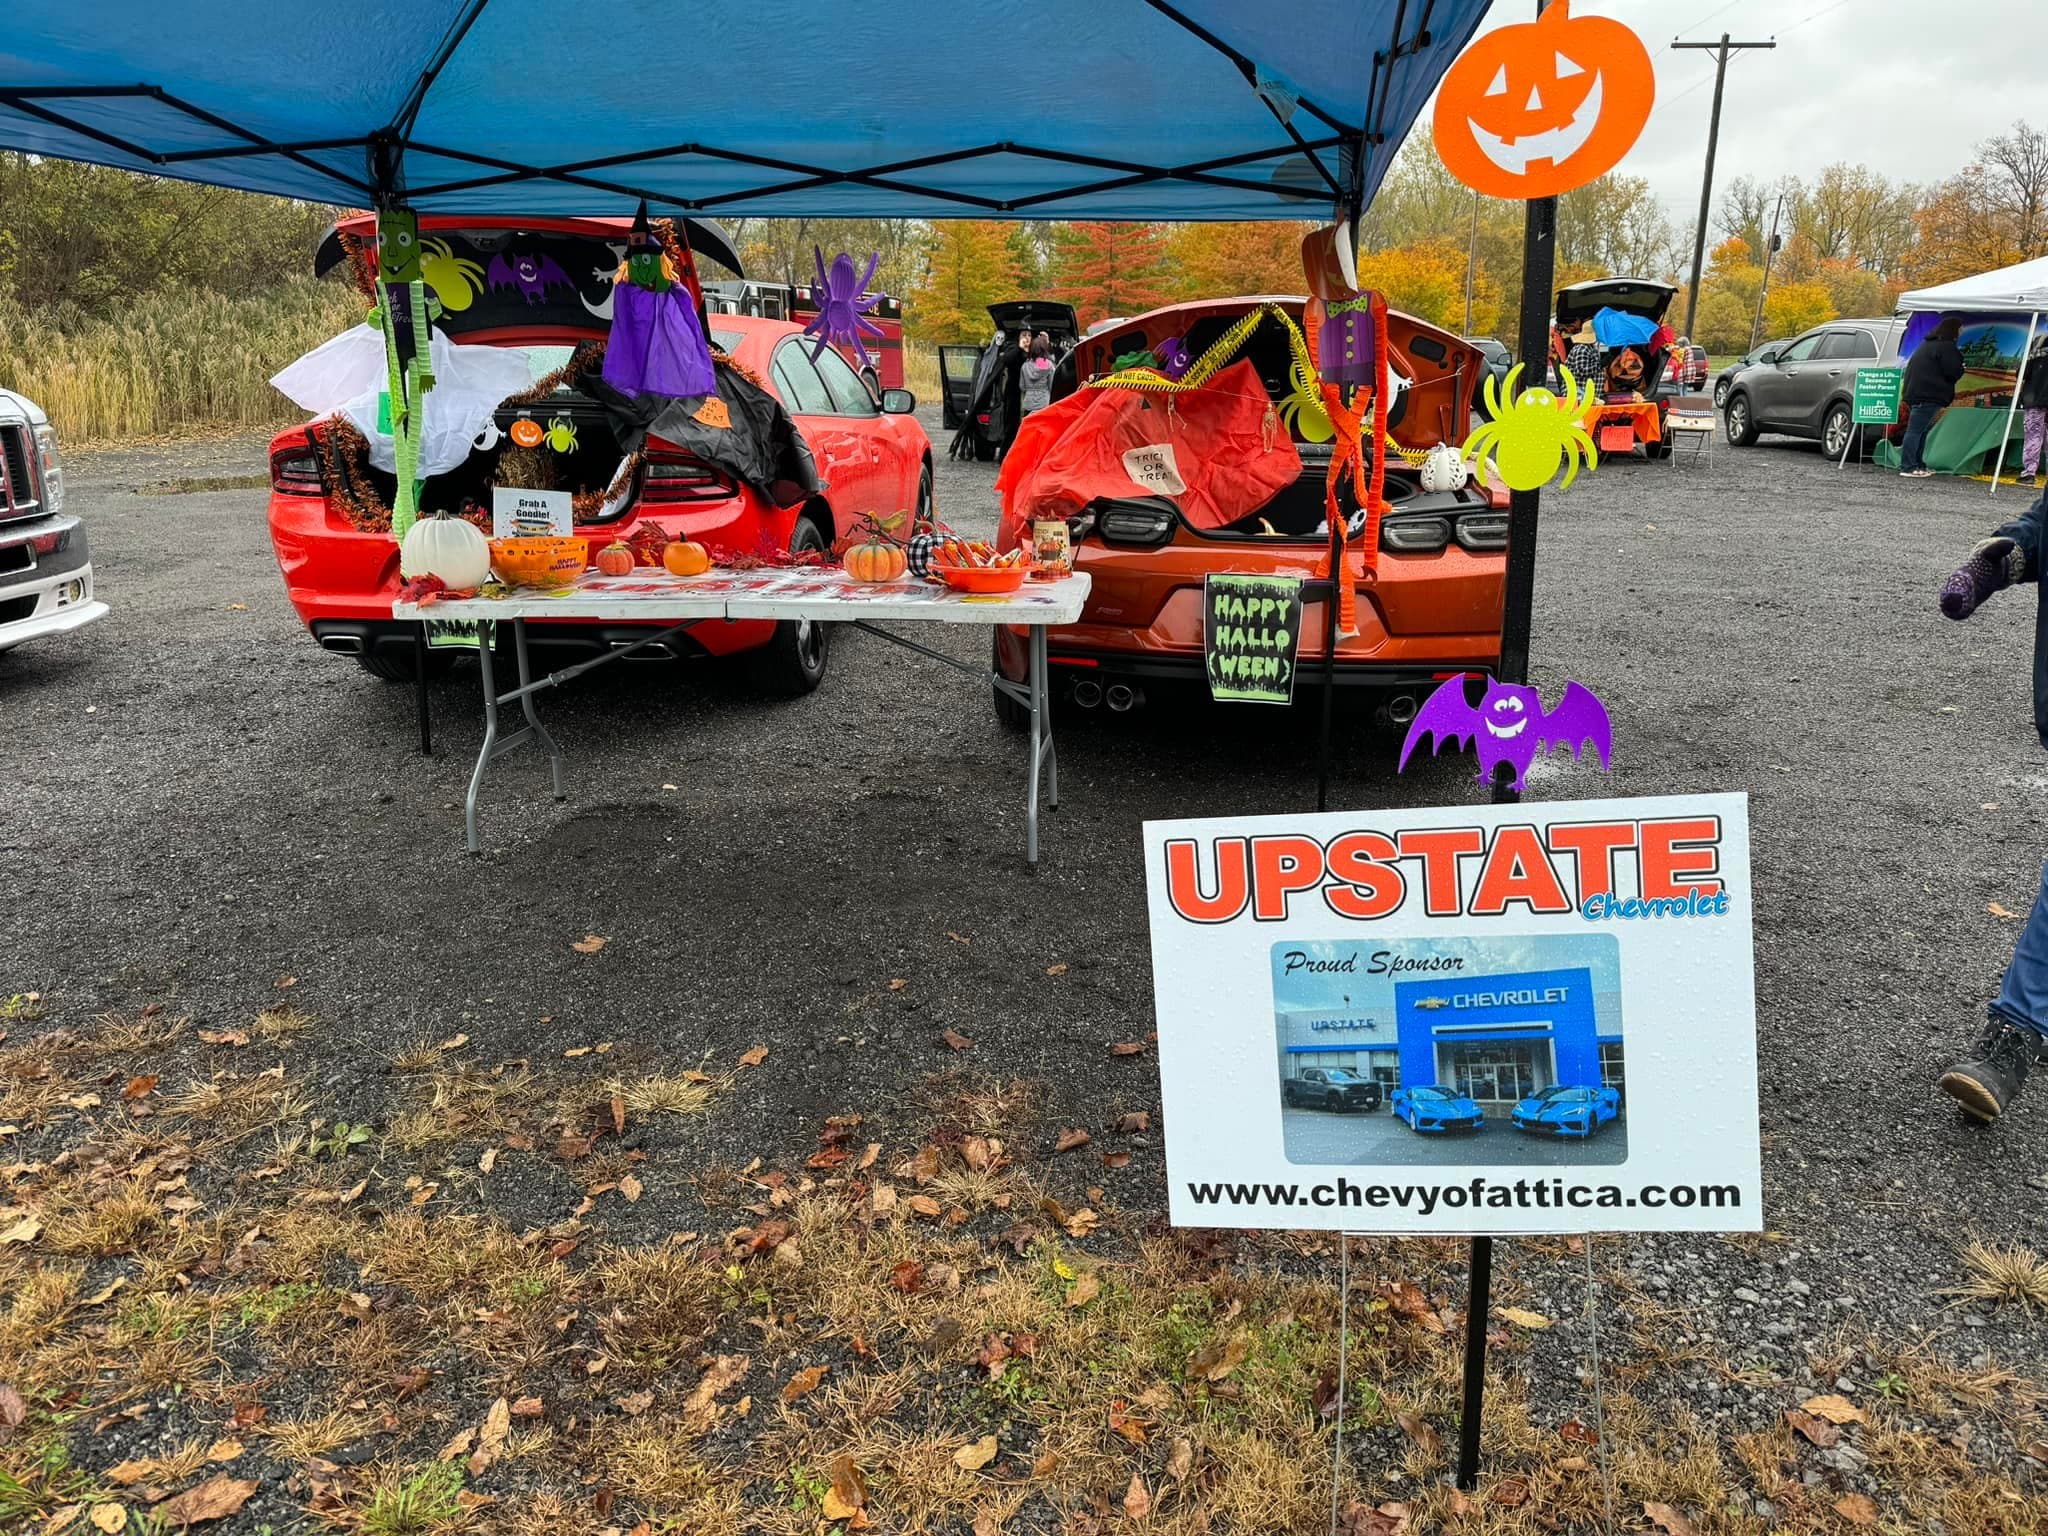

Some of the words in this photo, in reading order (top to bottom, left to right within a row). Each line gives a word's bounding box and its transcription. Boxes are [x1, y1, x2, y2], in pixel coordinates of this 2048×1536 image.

[1858, 404, 1893, 417] Hillside
[1143, 463, 1164, 472] OR
[516, 509, 551, 520] Goodie!
[518, 499, 540, 509] Grab
[540, 500, 547, 509] A
[1214, 594, 1291, 624] HAPPY
[1216, 625, 1291, 653] HALLO
[1164, 815, 1723, 923] UPSTATE
[1582, 888, 1731, 921] Chevrolet
[1284, 950, 1358, 977] Proud
[1366, 950, 1464, 979] Sponsor
[1452, 986, 1569, 1010] CHEVROLET
[1310, 1017, 1377, 1032] UPSTATE
[1187, 1177, 1741, 1215] www.chevyofattica.com
